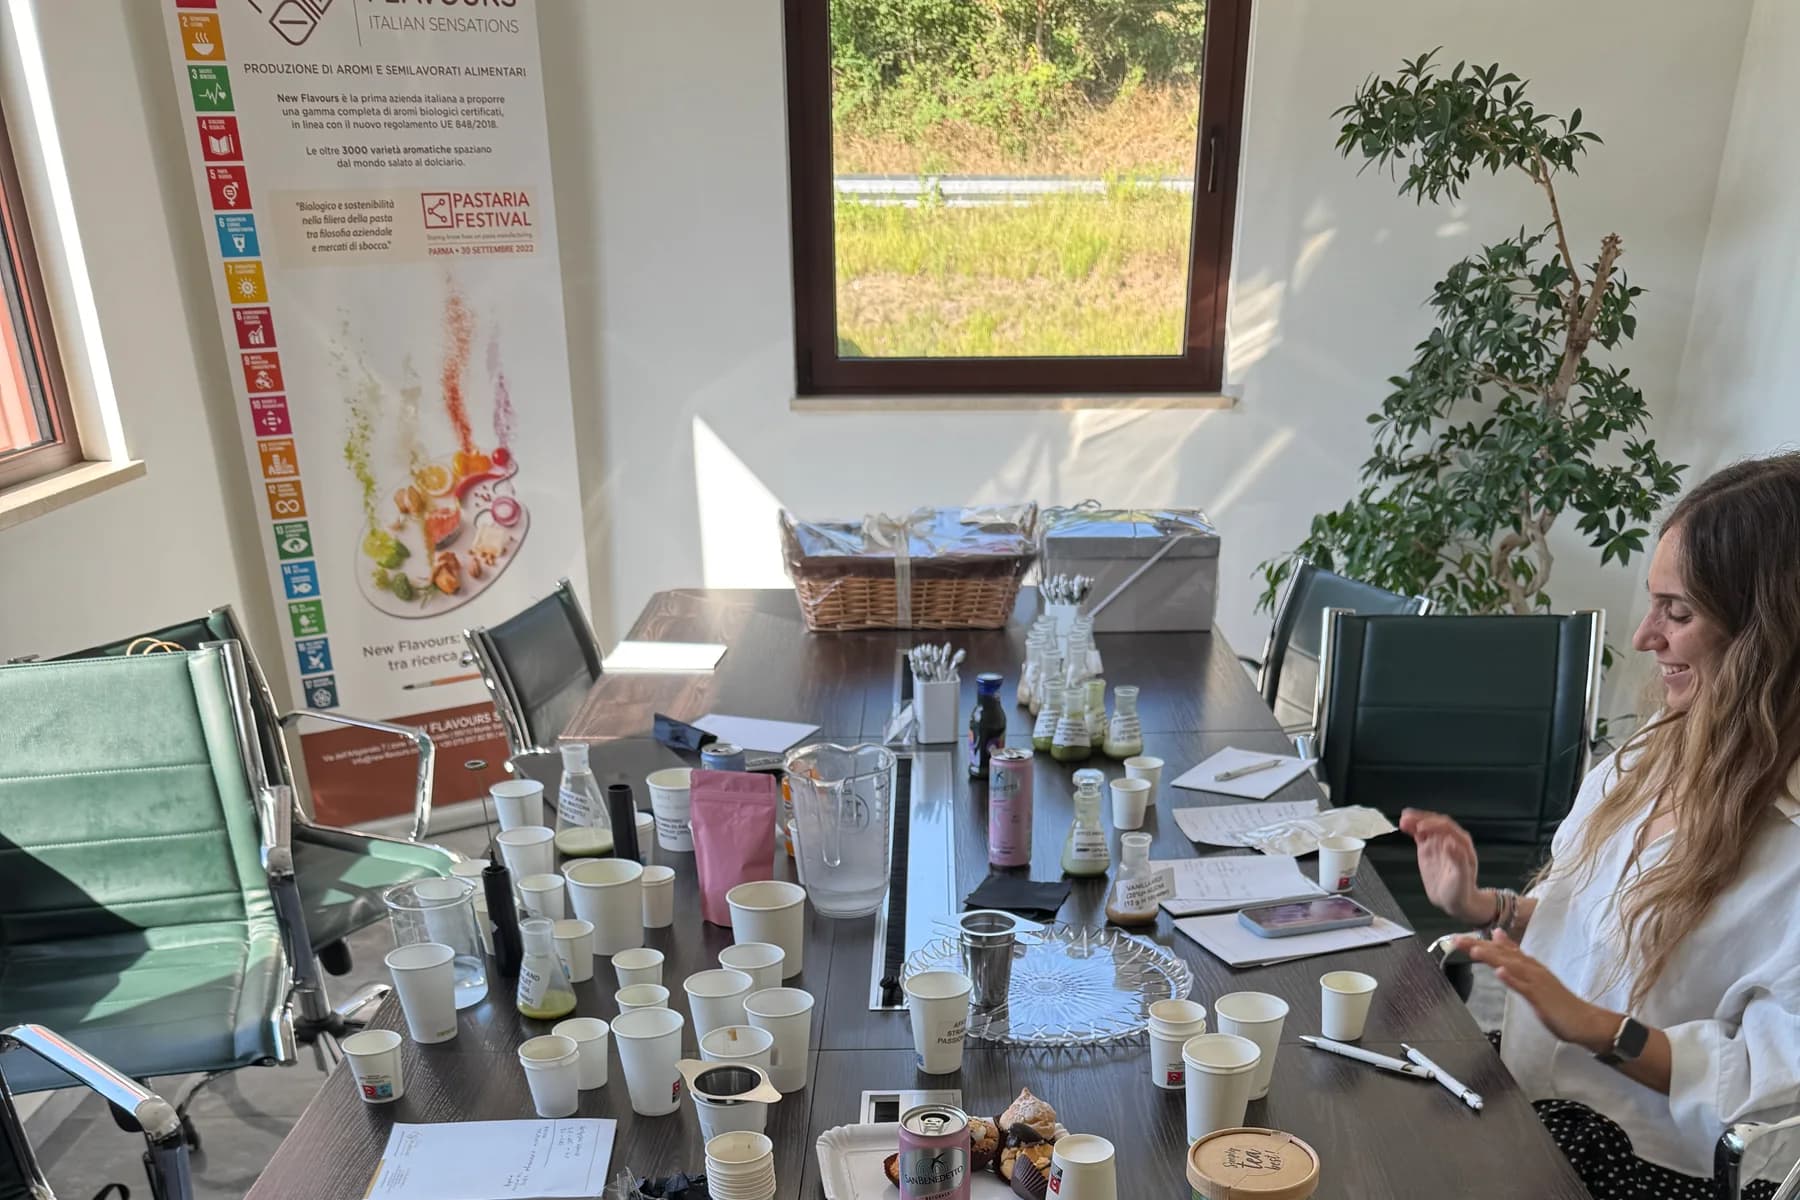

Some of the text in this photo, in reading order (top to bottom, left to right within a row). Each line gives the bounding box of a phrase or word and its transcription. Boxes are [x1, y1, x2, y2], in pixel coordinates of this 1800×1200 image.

[368, 15, 520, 34] ITALIAN SENSATIONS
[192, 68, 198, 80] 3
[243, 63, 527, 77] PRODUZIONE DI AROMI E SEMILAVORATI ALIMENTARI
[277, 93, 298, 103] New
[300, 93, 340, 103] Flavours
[350, 94, 358, 103] la
[361, 94, 388, 104] prima
[389, 94, 423, 103] azienda
[424, 94, 457, 103] italiana
[467, 96, 505, 105] proporre
[282, 107, 504, 117] una gamma completa di aromi biologici certificati,
[291, 120, 300, 128] in
[302, 120, 324, 129] linea
[326, 121, 342, 129] con
[345, 120, 351, 128] il
[383, 120, 438, 130] regolamento
[440, 120, 453, 128] UE
[306, 145, 492, 155] Le oltre 3000 varietà aromatiche spaziano
[337, 158, 466, 168] dal mondo salato al dolciario.
[344, 199, 395, 210] sostenibilità
[452, 192, 530, 208] PASTARIA
[302, 214, 393, 225] nella filiera della pasta
[455, 211, 532, 229] FESTIVAL
[306, 226, 393, 239] tra filosofia aziendale
[318, 243, 348, 252] mercati
[349, 241, 357, 251] di
[428, 247, 454, 256] PARMA
[461, 246, 471, 255] 30
[472, 245, 514, 254] SETTEMBRE
[362, 633, 462, 658] New Flavours:
[388, 659, 409, 671] tra
[411, 651, 459, 668] ricerca
[429, 713, 491, 732] FLAVOURS
[1237, 1148, 1263, 1169] tea
[1262, 1149, 1282, 1171] best!
